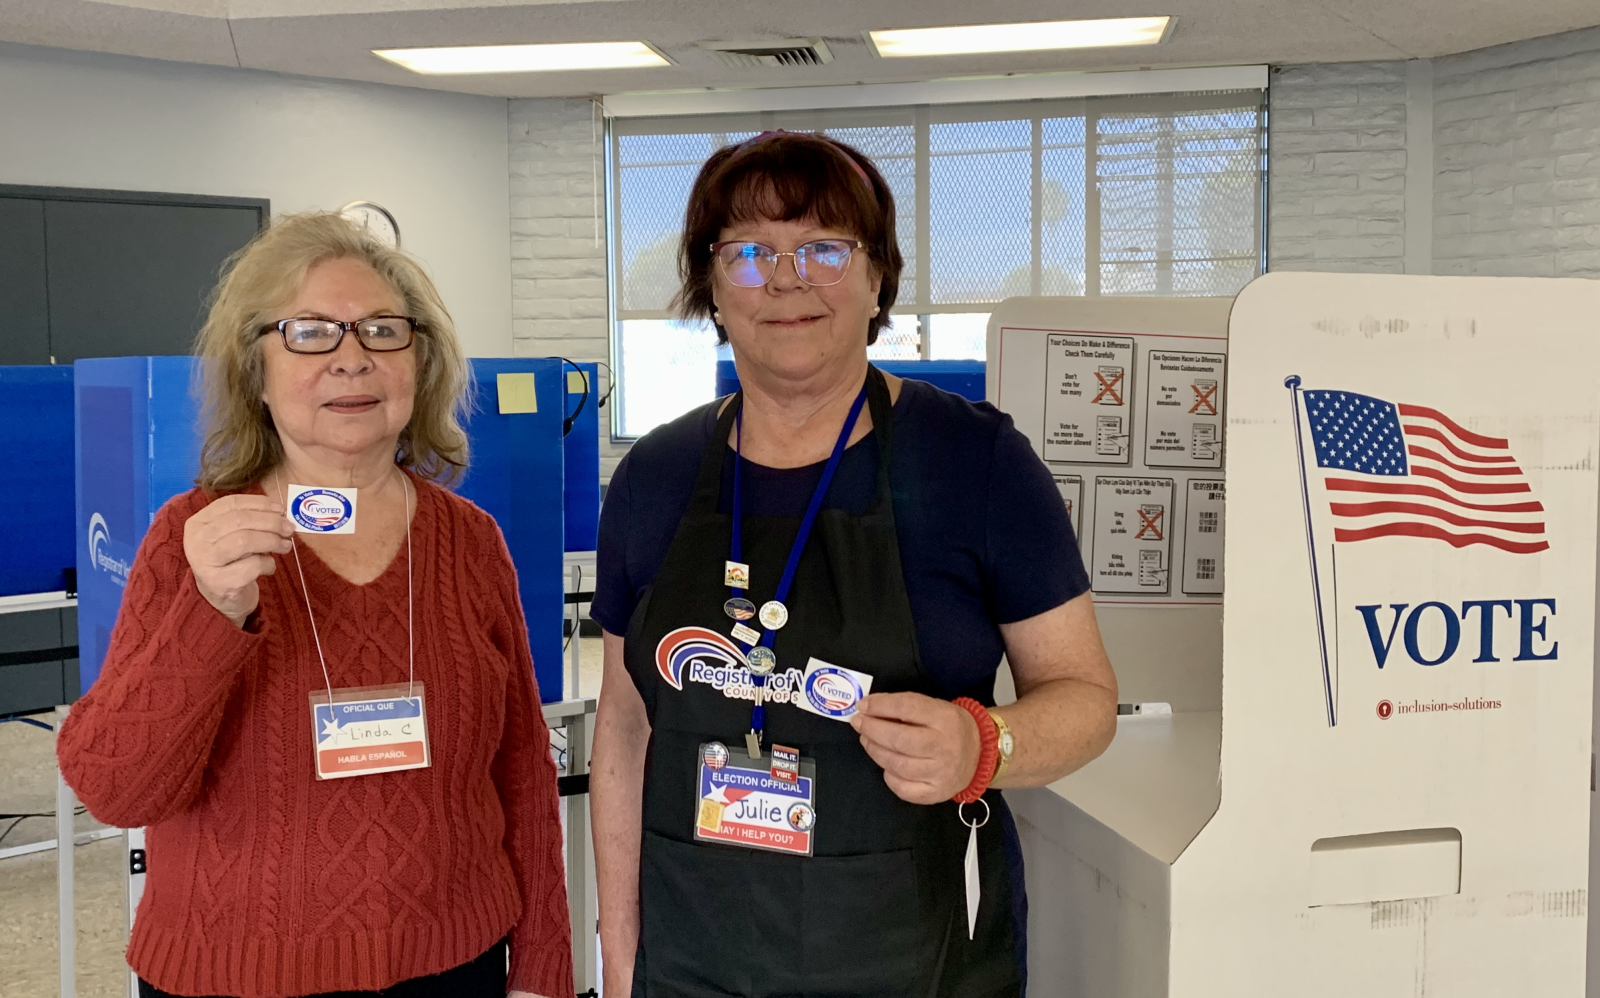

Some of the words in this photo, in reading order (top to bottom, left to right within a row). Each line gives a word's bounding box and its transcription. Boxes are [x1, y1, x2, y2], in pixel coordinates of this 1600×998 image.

[1095, 352, 1115, 360] Carefully
[1355, 598, 1558, 669] VOTE
[774, 671, 793, 689] of
[725, 687, 772, 700] COUNY
[775, 692, 788, 700] OF
[828, 687, 852, 700] VOTED
[343, 704, 375, 713] OFICIAL
[377, 702, 394, 710] QUE
[351, 724, 392, 740] Linda
[401, 723, 412, 735] C
[338, 754, 366, 764] HABLA
[369, 750, 407, 761] ESPAÑOL
[774, 750, 789, 759] MAIL
[773, 760, 789, 769] DROP
[776, 770, 792, 780] VISIT.
[712, 772, 758, 786] ELECTION
[761, 778, 802, 793] OFFICIAL
[735, 799, 782, 822] Julie
[736, 828, 740, 836] I
[742, 830, 766, 840] HELP
[769, 833, 794, 845] YOU?
